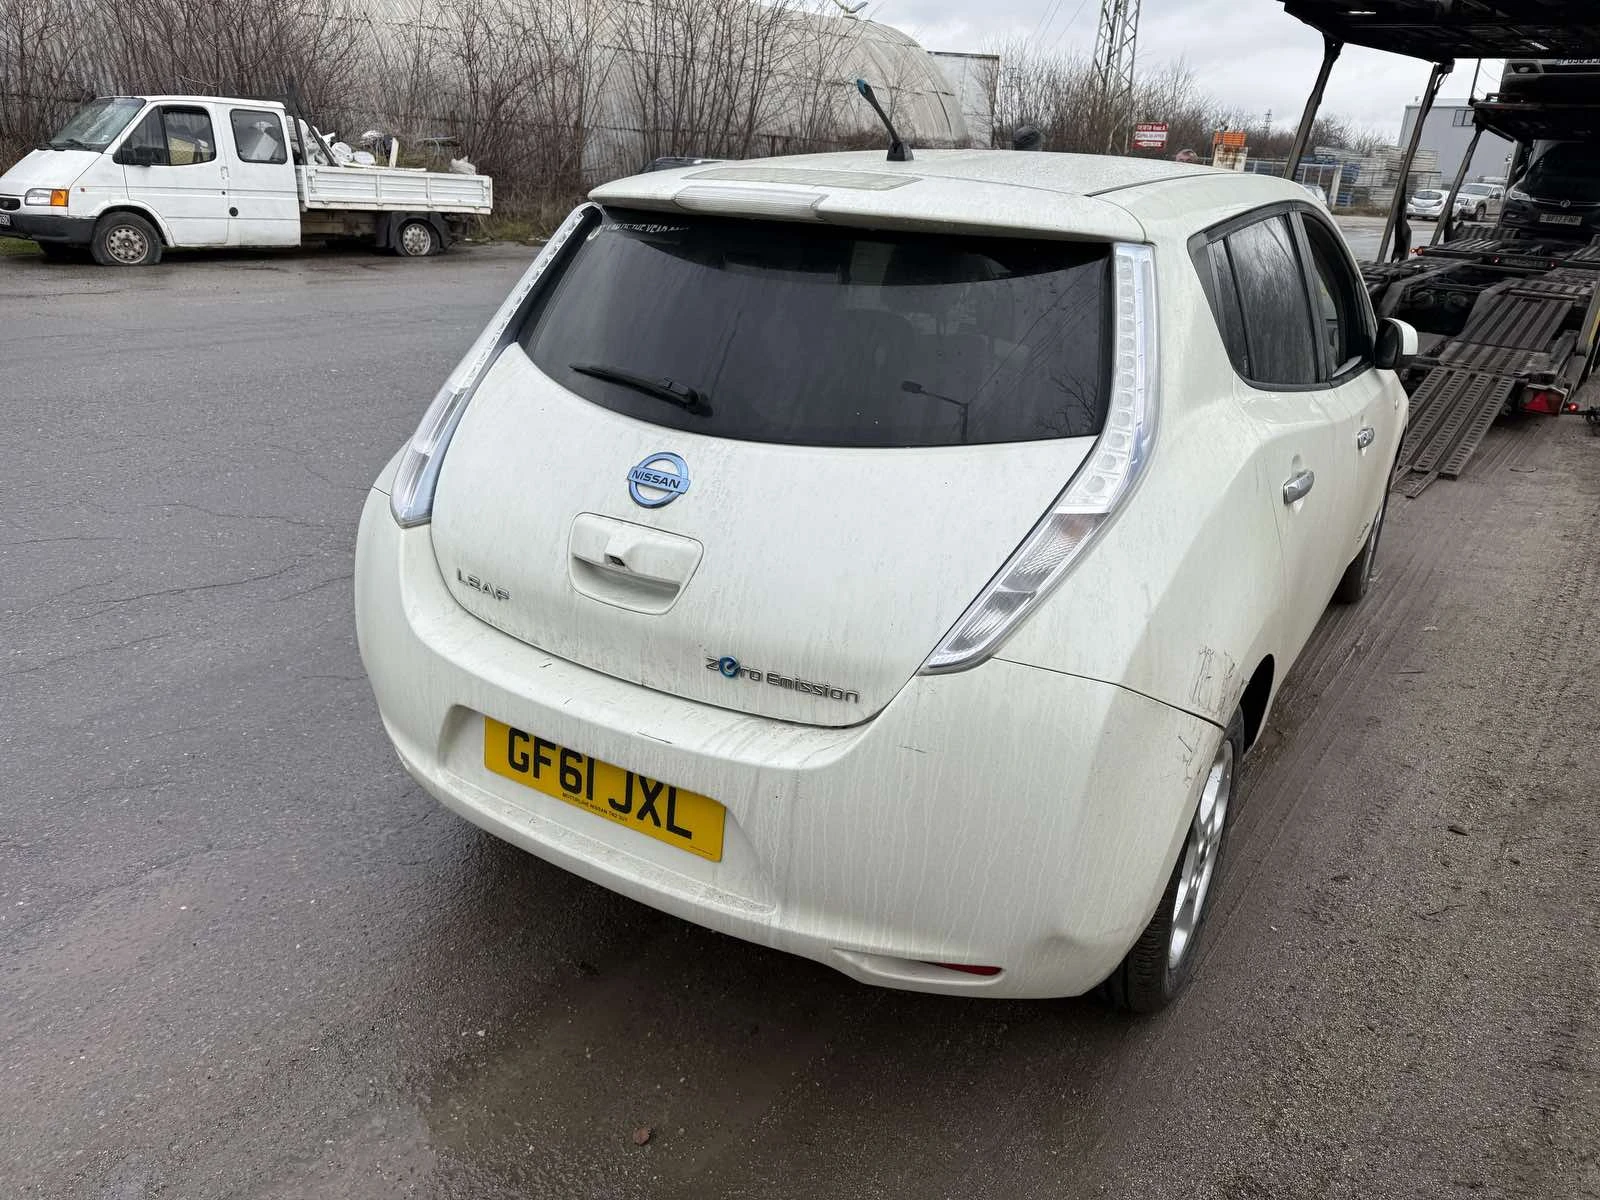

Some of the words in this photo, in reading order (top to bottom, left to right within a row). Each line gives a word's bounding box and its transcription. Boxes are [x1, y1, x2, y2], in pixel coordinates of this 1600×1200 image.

[631, 469, 681, 489] NISSAN
[456, 567, 512, 602] LEAF
[766, 670, 860, 704] Emission
[508, 726, 598, 801] GF61
[608, 769, 693, 841] JXL
